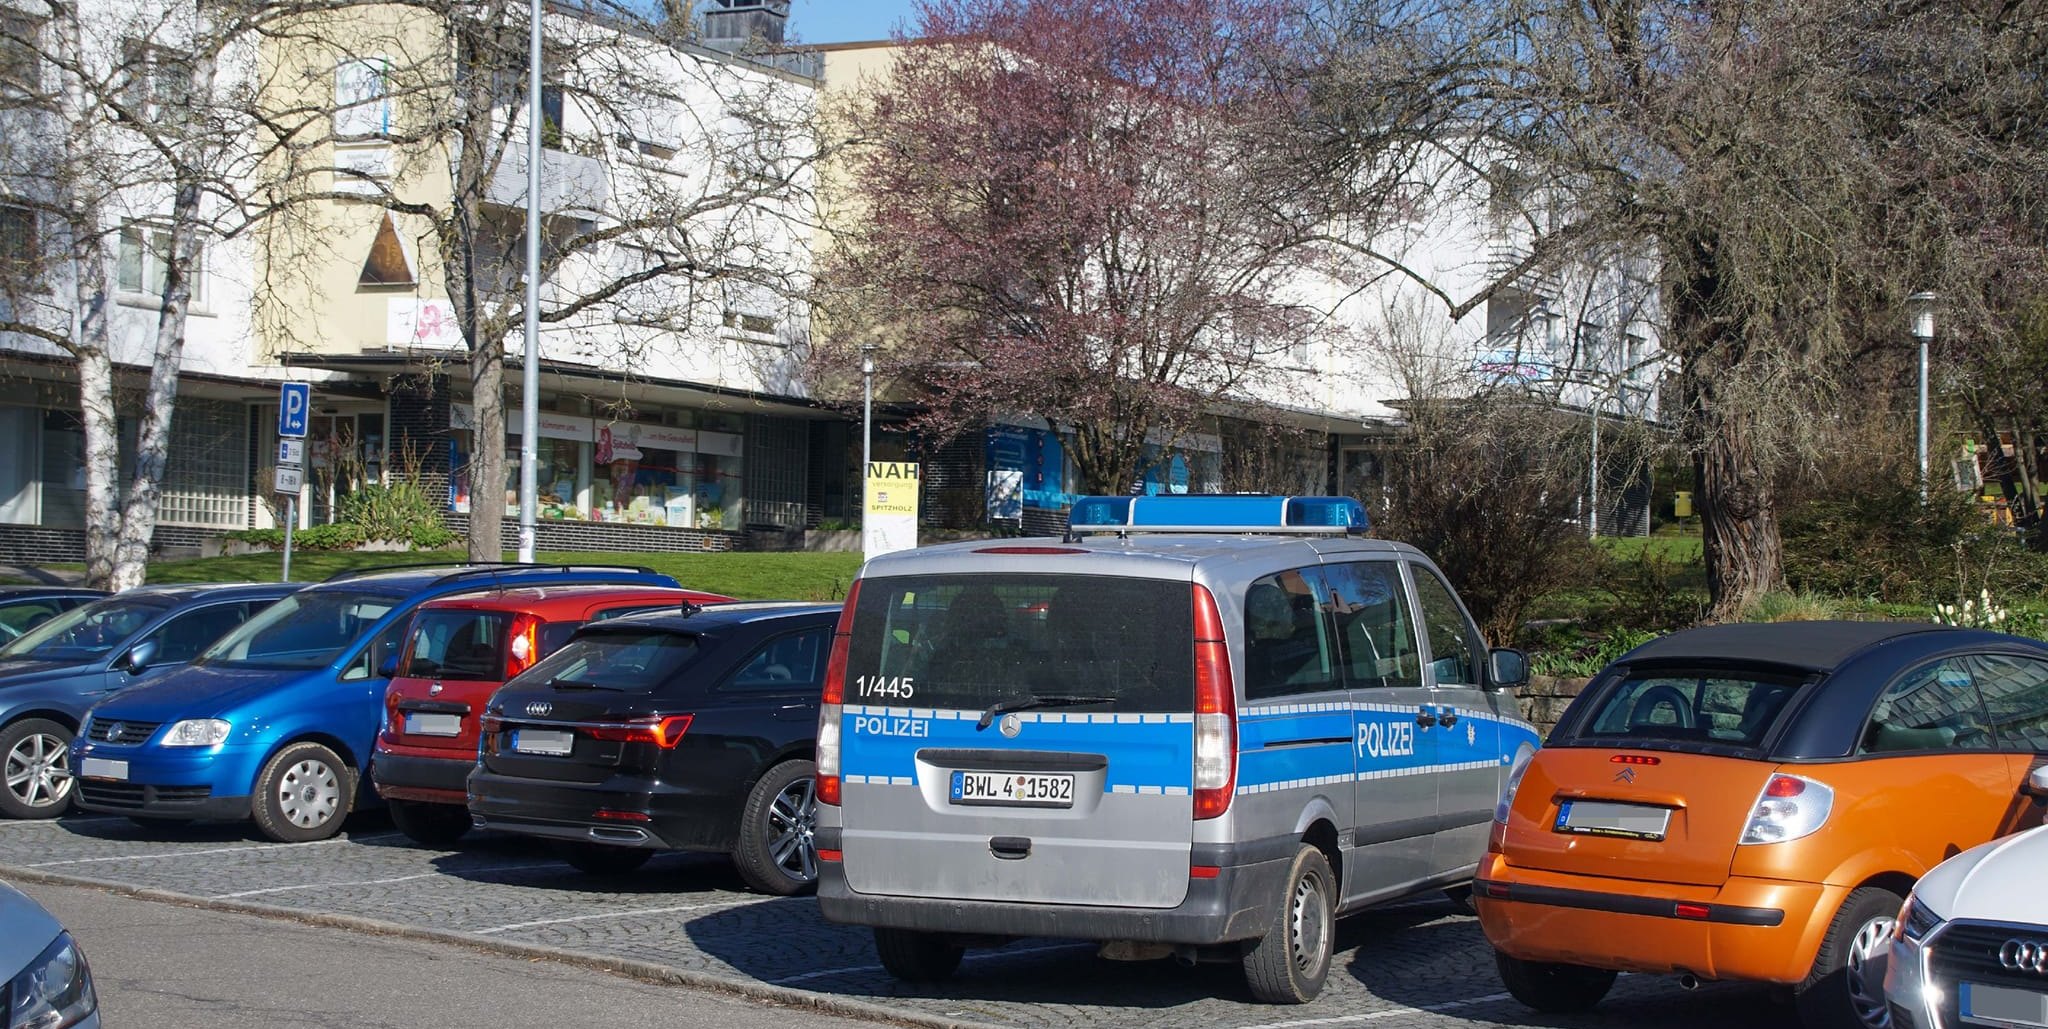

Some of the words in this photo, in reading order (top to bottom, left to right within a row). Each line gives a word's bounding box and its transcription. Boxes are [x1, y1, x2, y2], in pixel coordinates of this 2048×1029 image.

[286, 390, 303, 429] P
[867, 463, 918, 479] NAH
[871, 504, 913, 512] SPITZHOLZ
[856, 675, 914, 699] 1/445
[855, 716, 929, 738] POLIZEI
[1357, 721, 1414, 758] POLIZEI
[964, 775, 997, 796] BWL
[1003, 776, 1013, 797] 4
[1026, 777, 1071, 799] 1582
